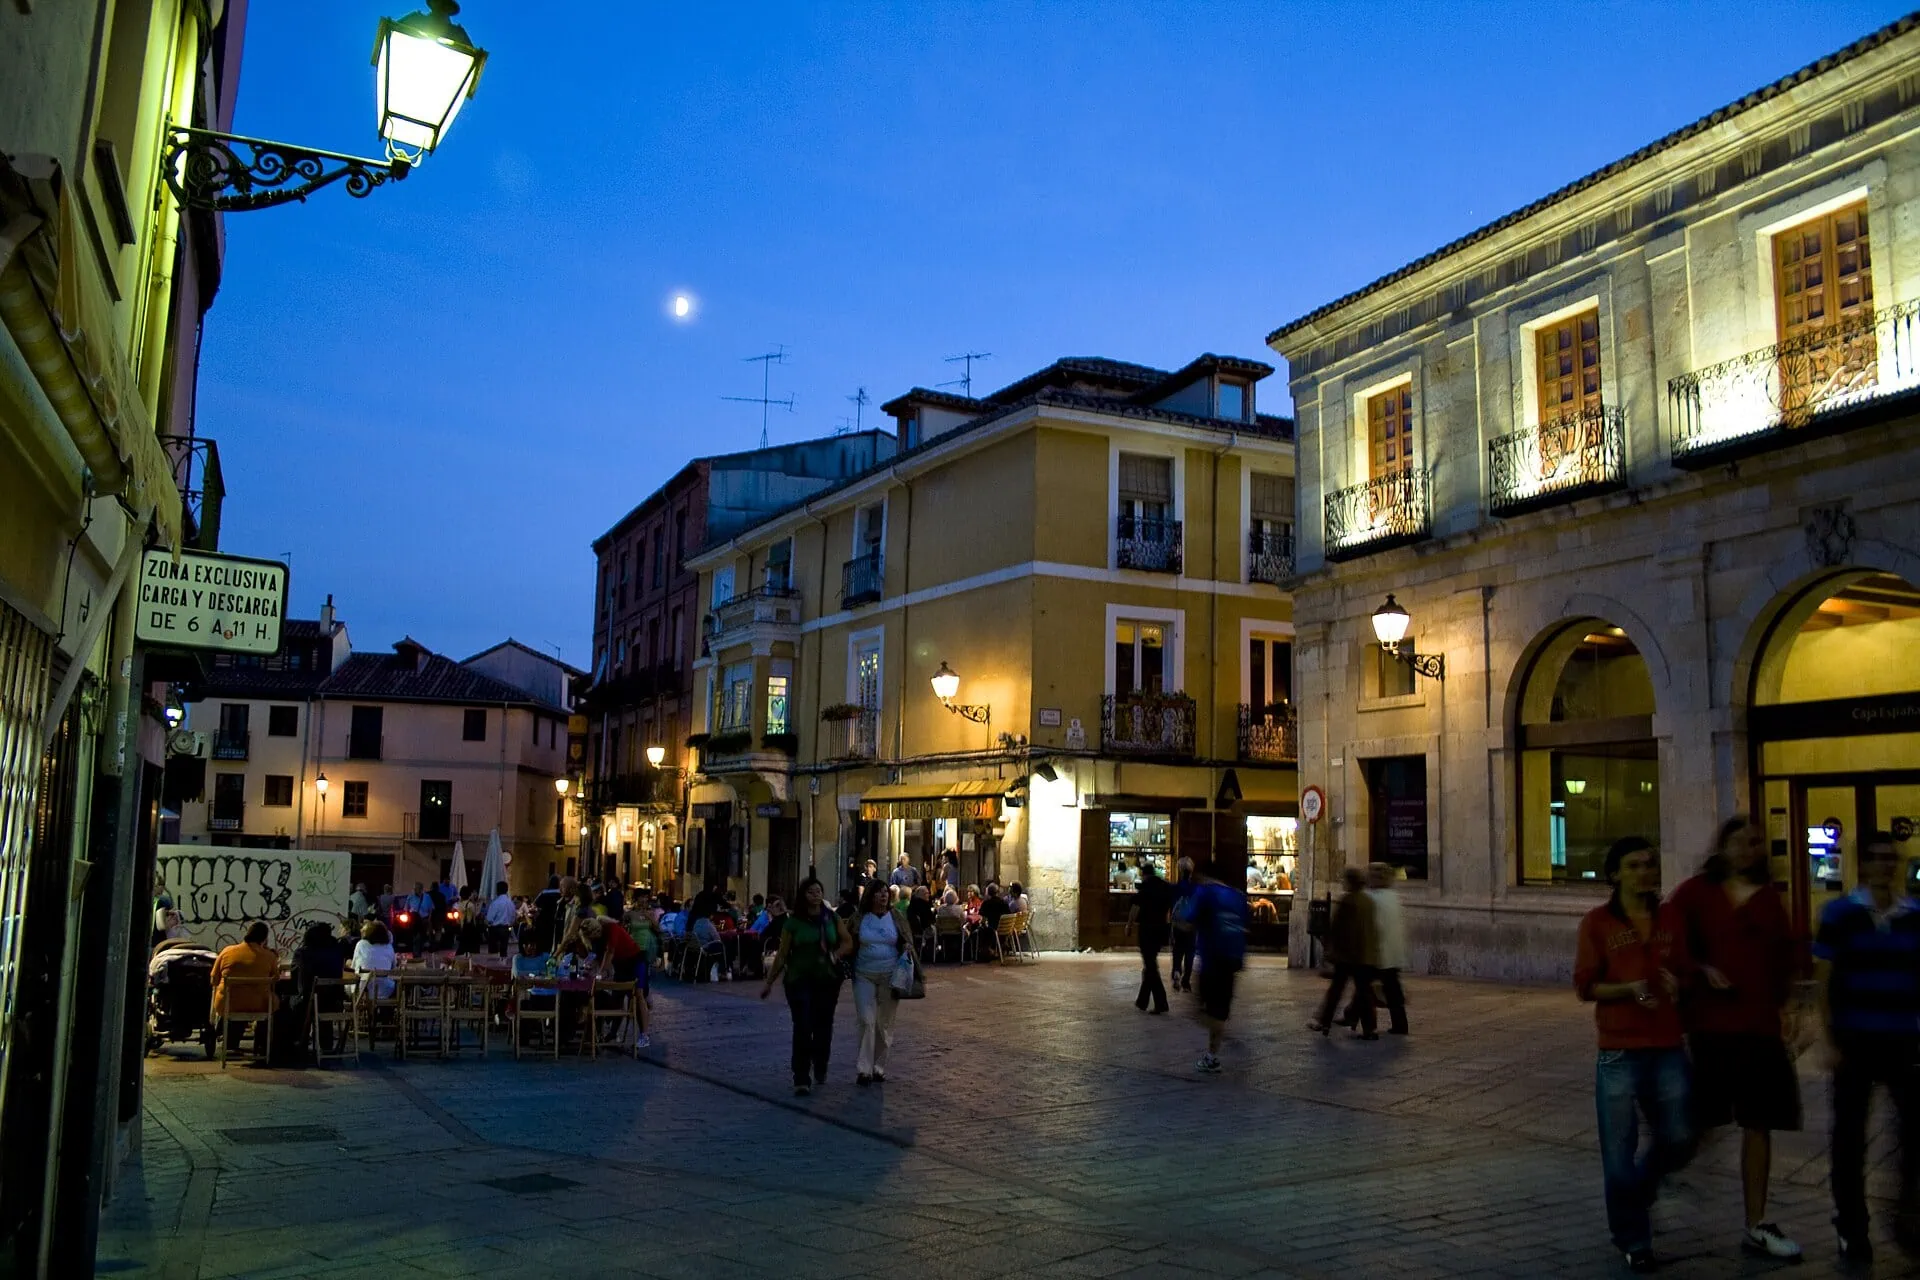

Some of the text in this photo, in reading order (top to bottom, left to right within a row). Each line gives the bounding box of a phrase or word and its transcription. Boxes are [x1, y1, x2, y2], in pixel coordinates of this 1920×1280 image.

[148, 559, 277, 592] ZONA EXCLUSIVA
[142, 584, 278, 617] CARGA Y DESCARGA
[151, 611, 177, 630] DE
[187, 616, 200, 632] 6
[211, 619, 222, 635] A
[233, 621, 245, 637] 11
[898, 801, 934, 819] Latino
